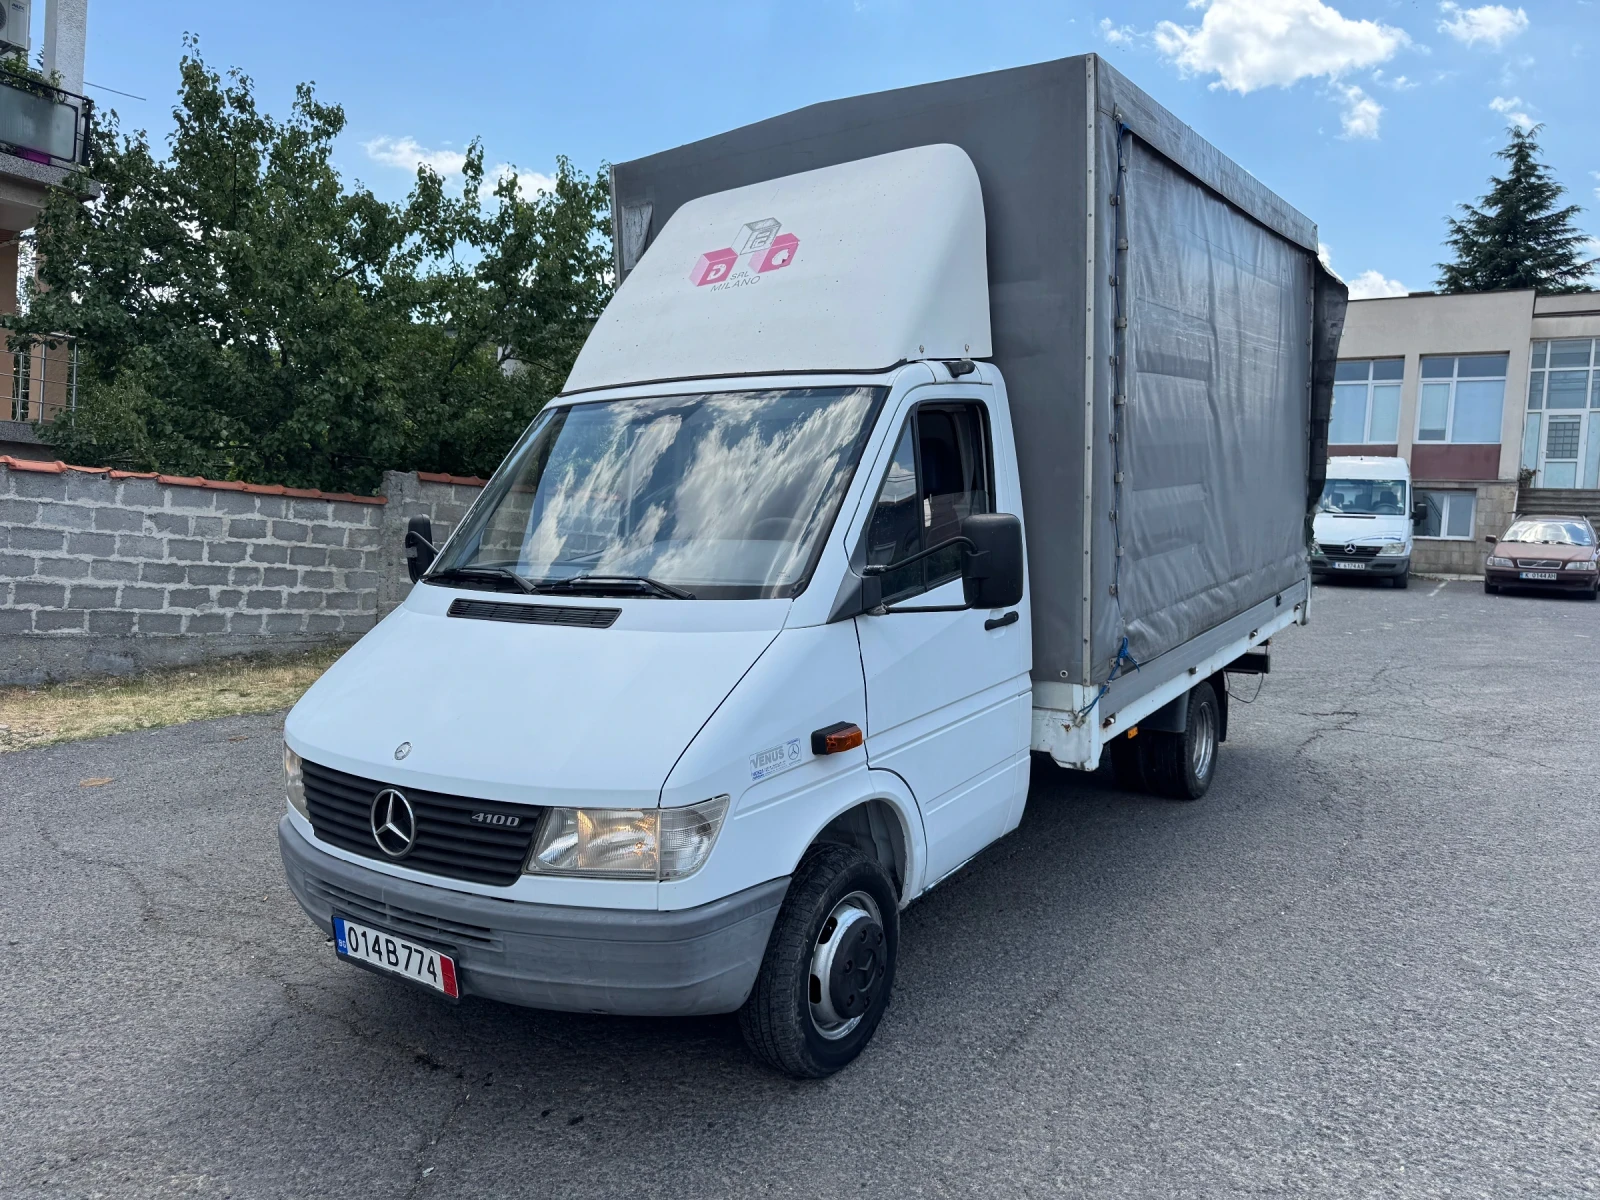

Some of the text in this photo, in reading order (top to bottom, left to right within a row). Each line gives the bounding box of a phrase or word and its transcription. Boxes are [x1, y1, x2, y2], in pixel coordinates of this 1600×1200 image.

[710, 275, 761, 292] MILANO
[730, 271, 749, 281] SRL
[750, 746, 785, 769] VENUS
[338, 926, 438, 983] BG 014B774
